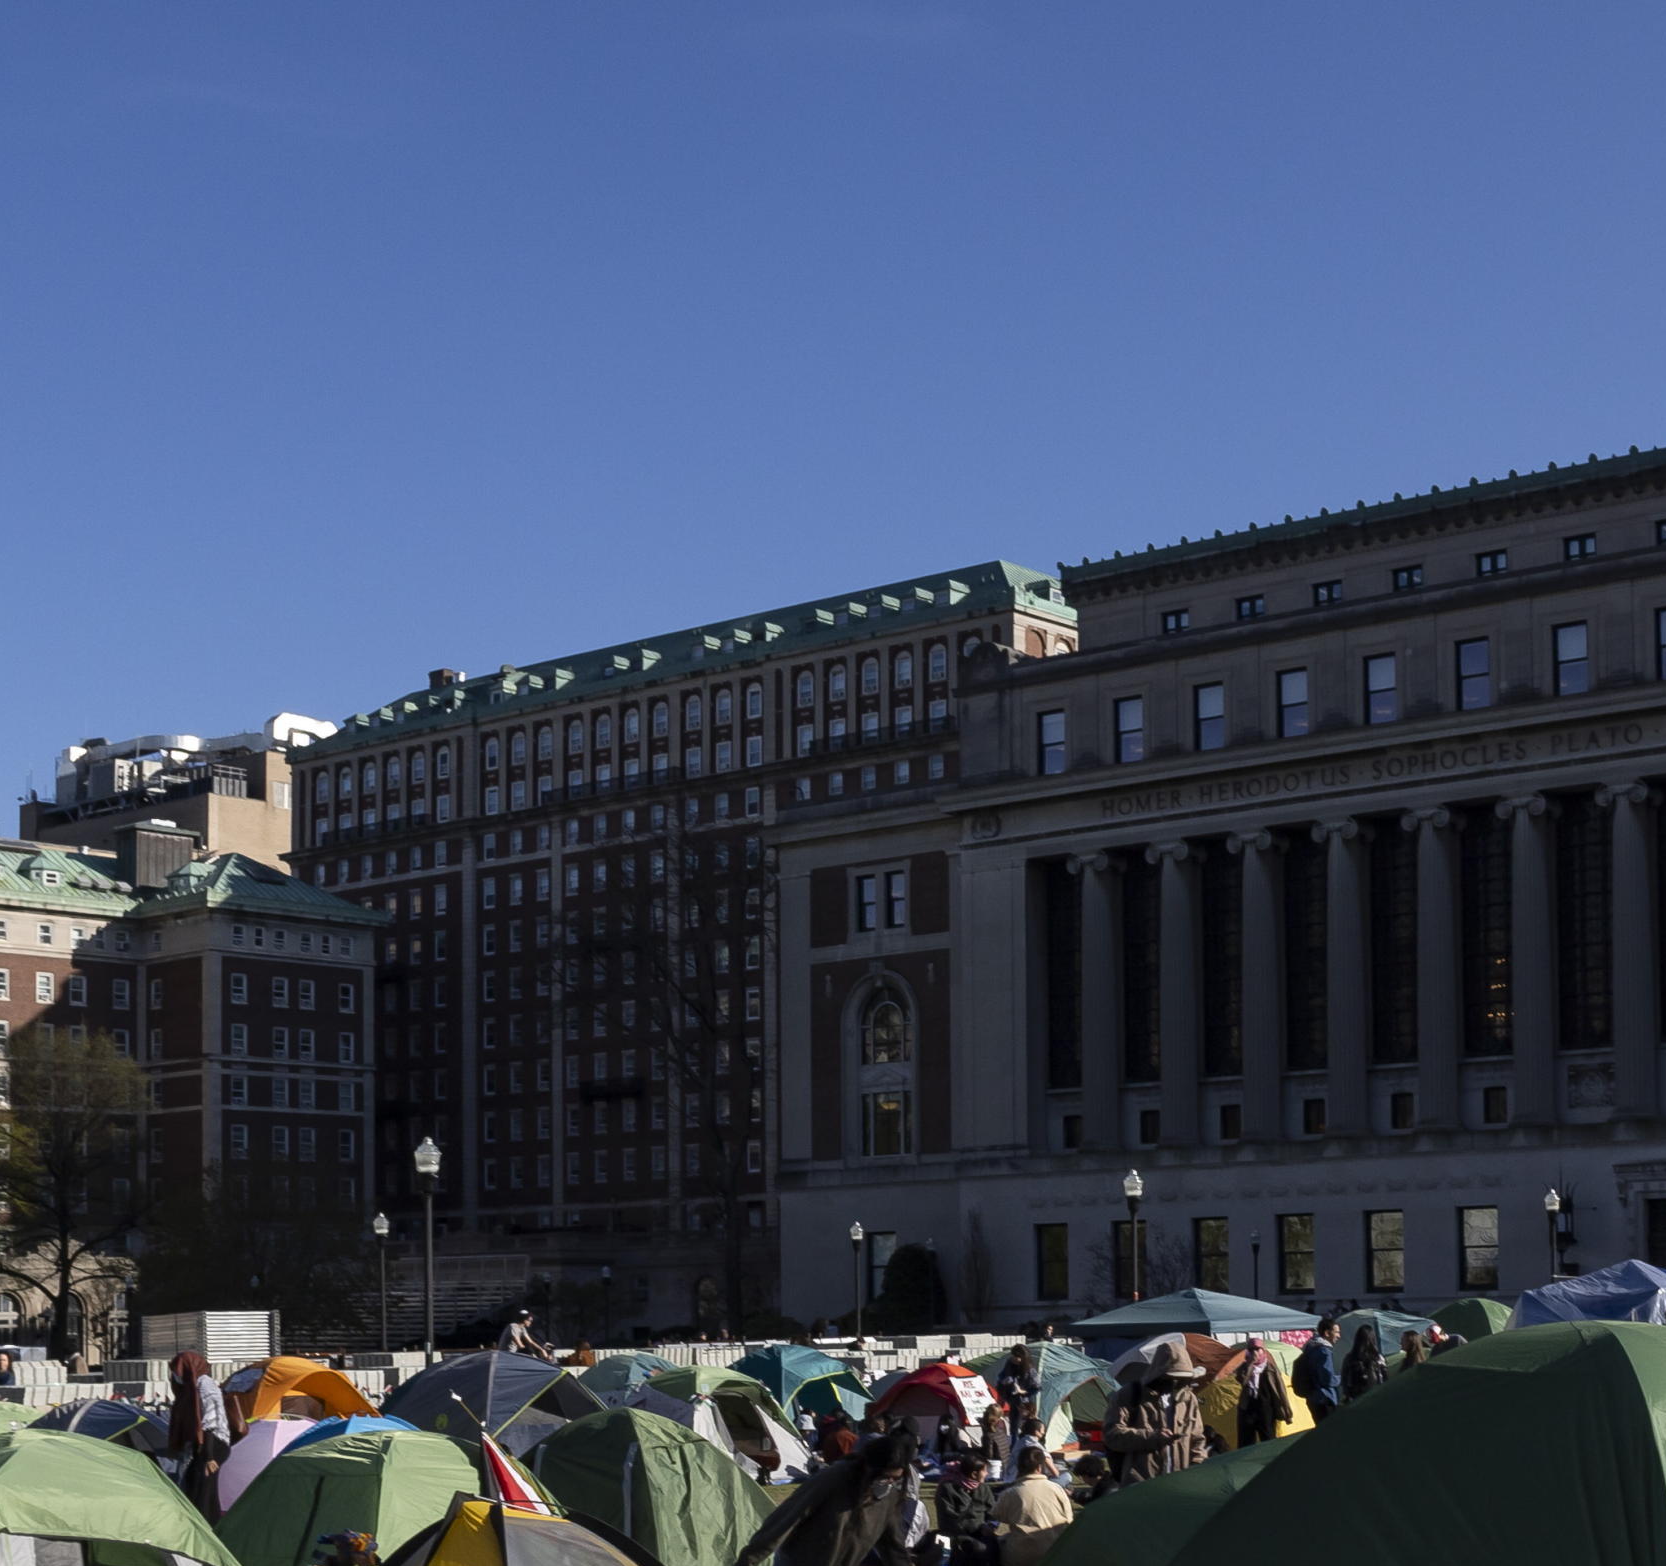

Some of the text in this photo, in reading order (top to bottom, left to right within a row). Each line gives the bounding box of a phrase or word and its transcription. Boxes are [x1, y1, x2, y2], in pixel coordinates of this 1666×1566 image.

[1102, 791, 1182, 818] HOMER
[1199, 766, 1351, 806] HERODOTUS
[1373, 739, 1527, 781] SOPHOCLES
[1550, 722, 1643, 756] PLATO
